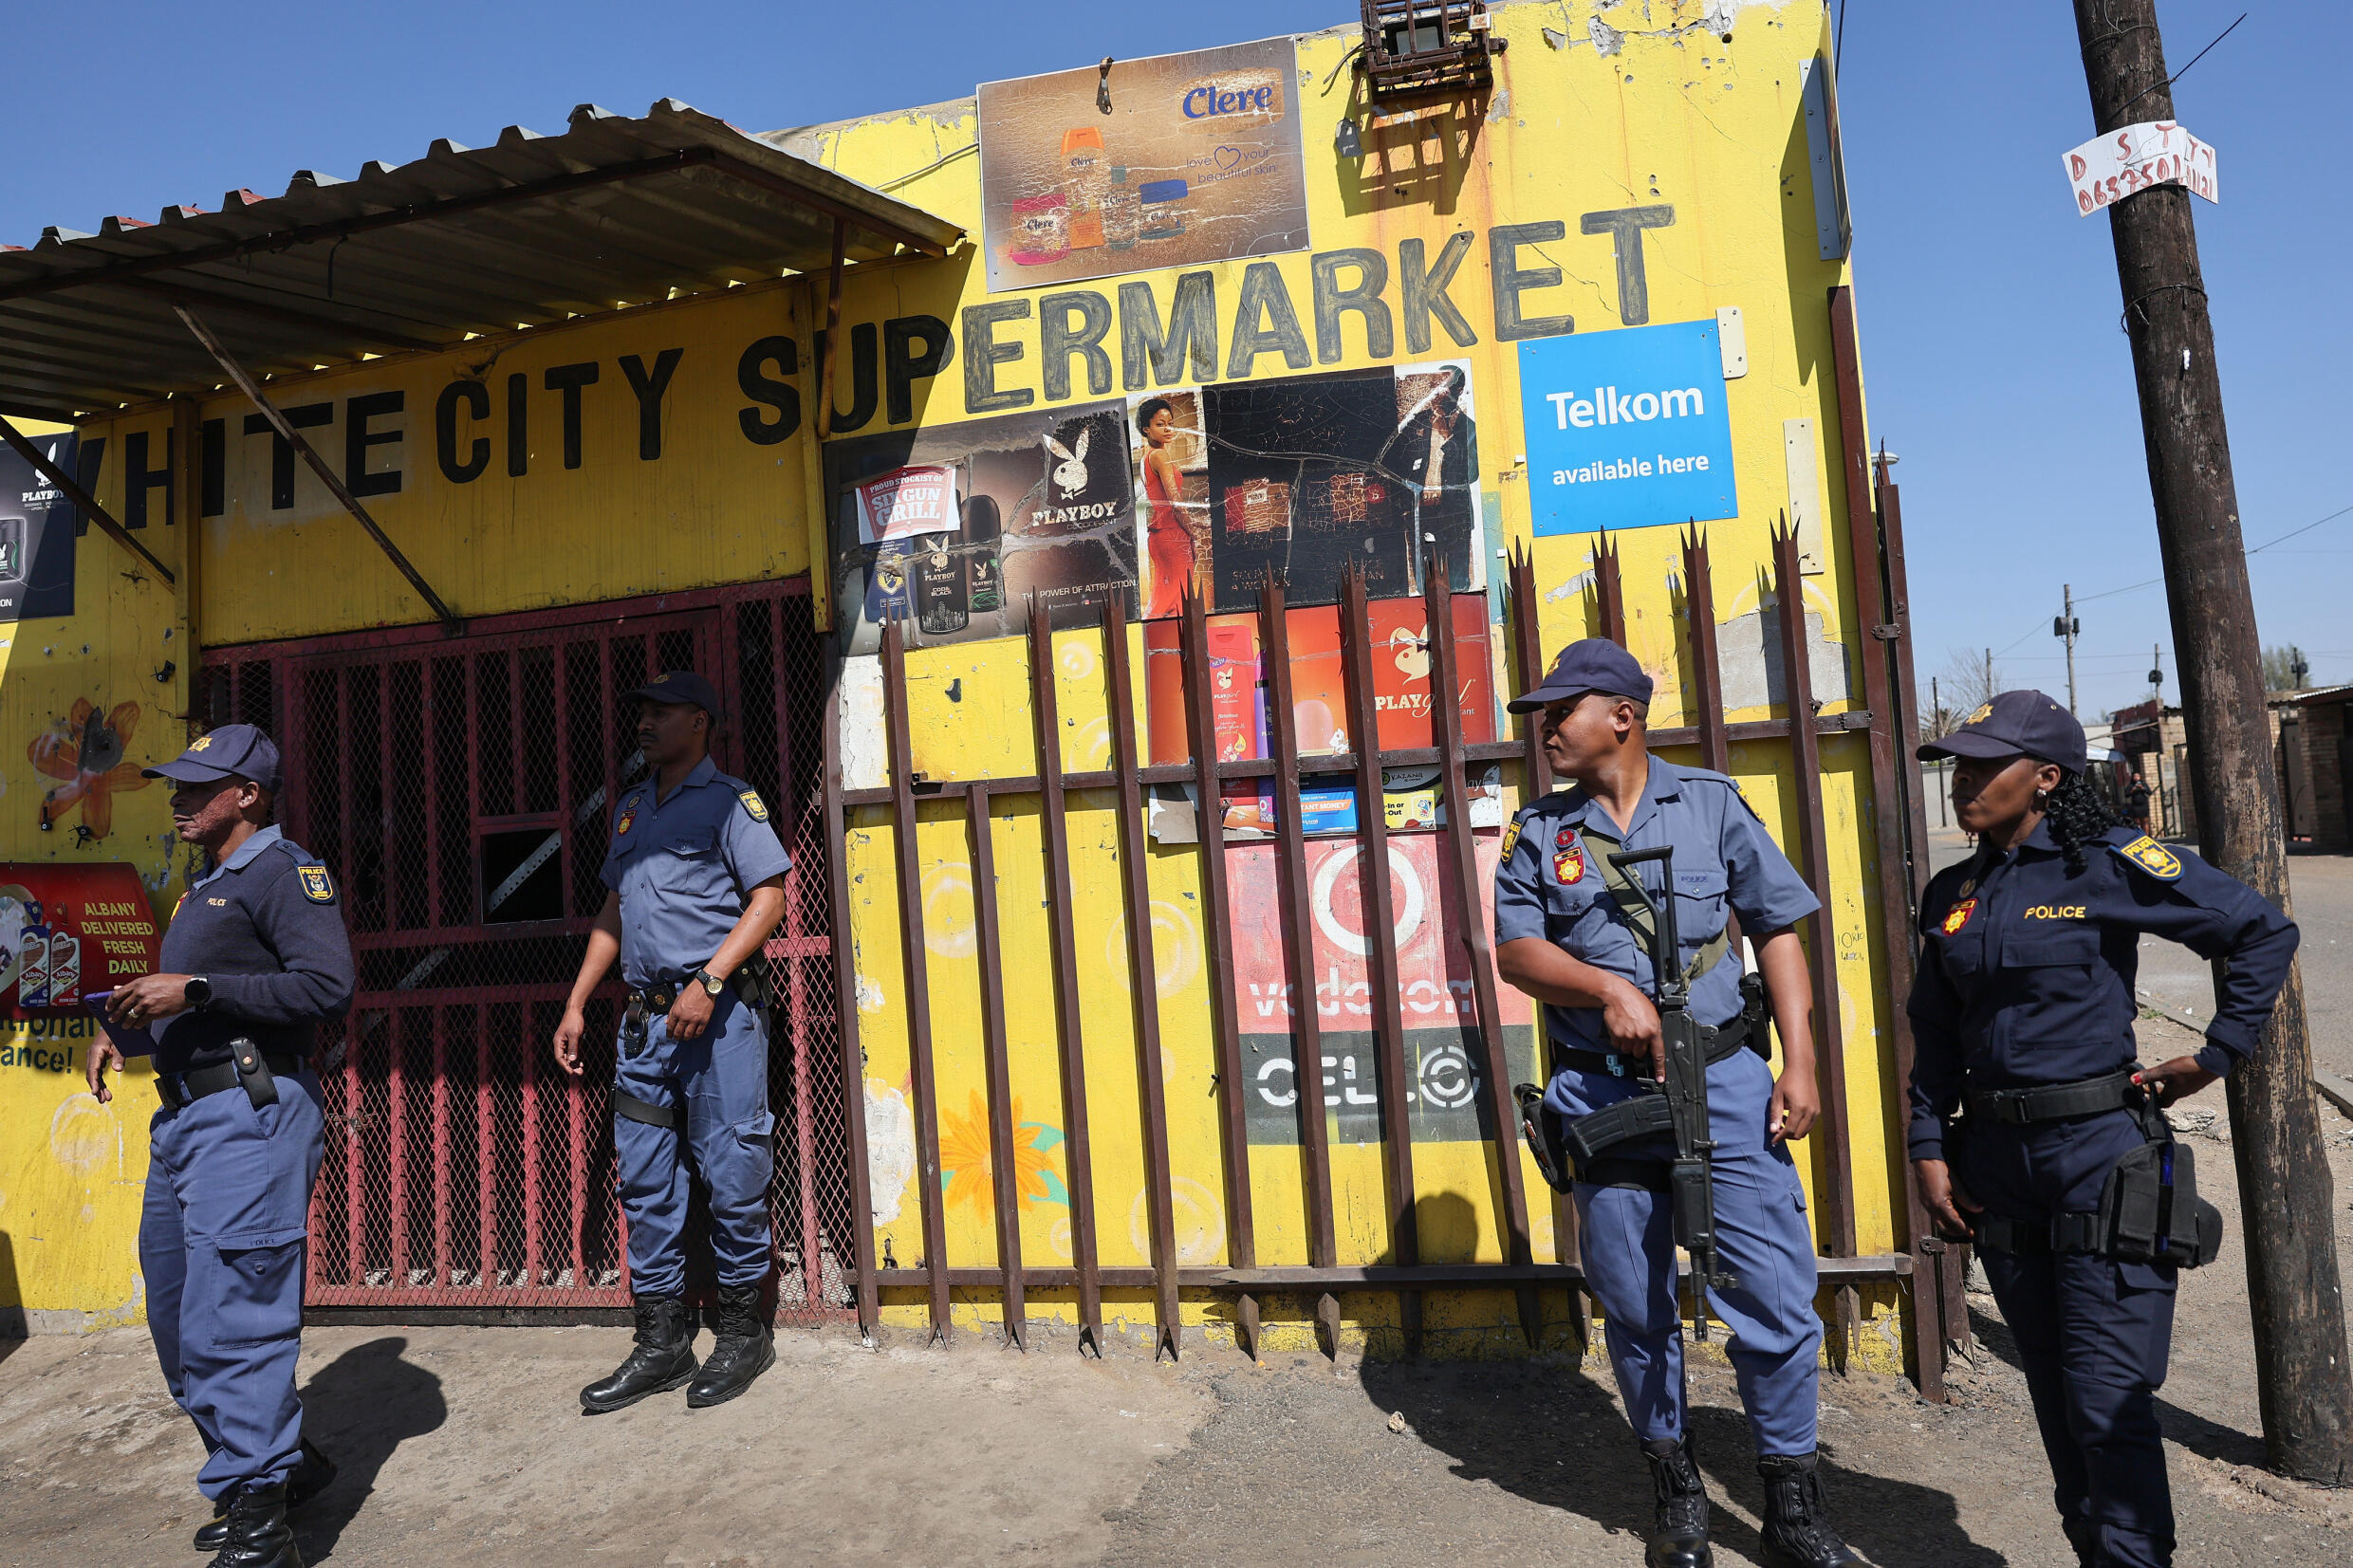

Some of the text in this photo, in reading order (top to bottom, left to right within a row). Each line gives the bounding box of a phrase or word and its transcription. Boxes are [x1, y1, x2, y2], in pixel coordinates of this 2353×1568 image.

[1182, 84, 1273, 119] Clere
[1186, 149, 1269, 169] love your
[1197, 163, 1276, 183] beautiful skin
[1027, 218, 1055, 231] Clere
[76, 202, 1677, 538] HITE CITY SUPERMARKET
[1546, 385, 1704, 430] Telkom
[1552, 453, 1709, 485] available here
[869, 479, 895, 493] PROUD
[895, 474, 934, 486] STOCKIST
[872, 487, 941, 510] SIX GUN
[876, 501, 941, 526] GRILL
[1031, 500, 1117, 527] PLAYBOY
[924, 570, 957, 581] PLAYBOY
[1040, 586, 1070, 599] POWER
[1072, 585, 1083, 594] OF
[1319, 802, 1345, 810] MONEY
[84, 902, 137, 916] ALBANY
[2024, 905, 2086, 920] POLICE
[80, 921, 154, 935] DELIVERED
[102, 940, 147, 954] FRESH
[108, 959, 149, 974] DAILY
